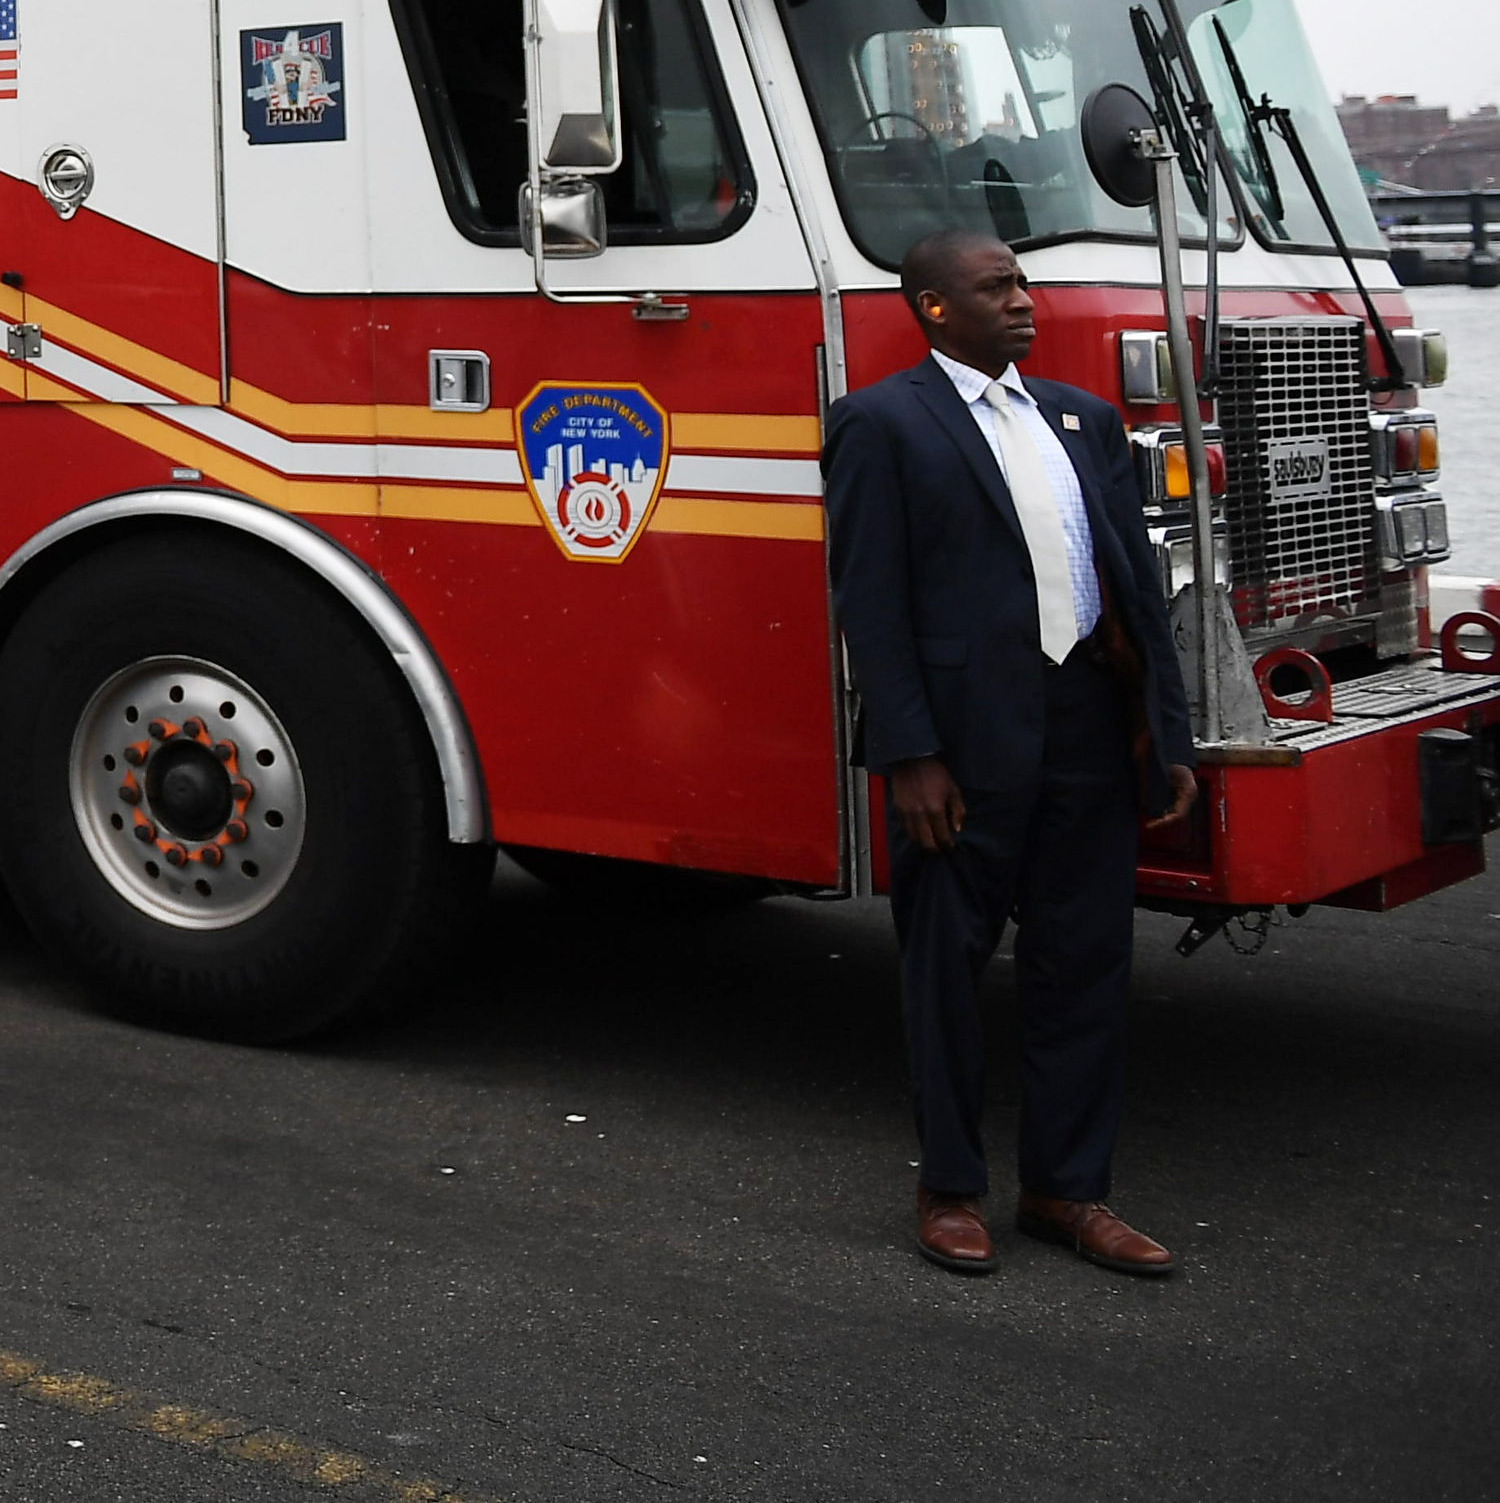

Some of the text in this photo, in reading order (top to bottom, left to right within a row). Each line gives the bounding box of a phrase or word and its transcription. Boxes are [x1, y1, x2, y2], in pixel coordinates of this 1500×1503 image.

[267, 104, 324, 124] FDNY
[531, 394, 653, 438] FIRE DEPARTMENT
[569, 417, 614, 427] CITY OF
[562, 428, 620, 438] NEW YORK
